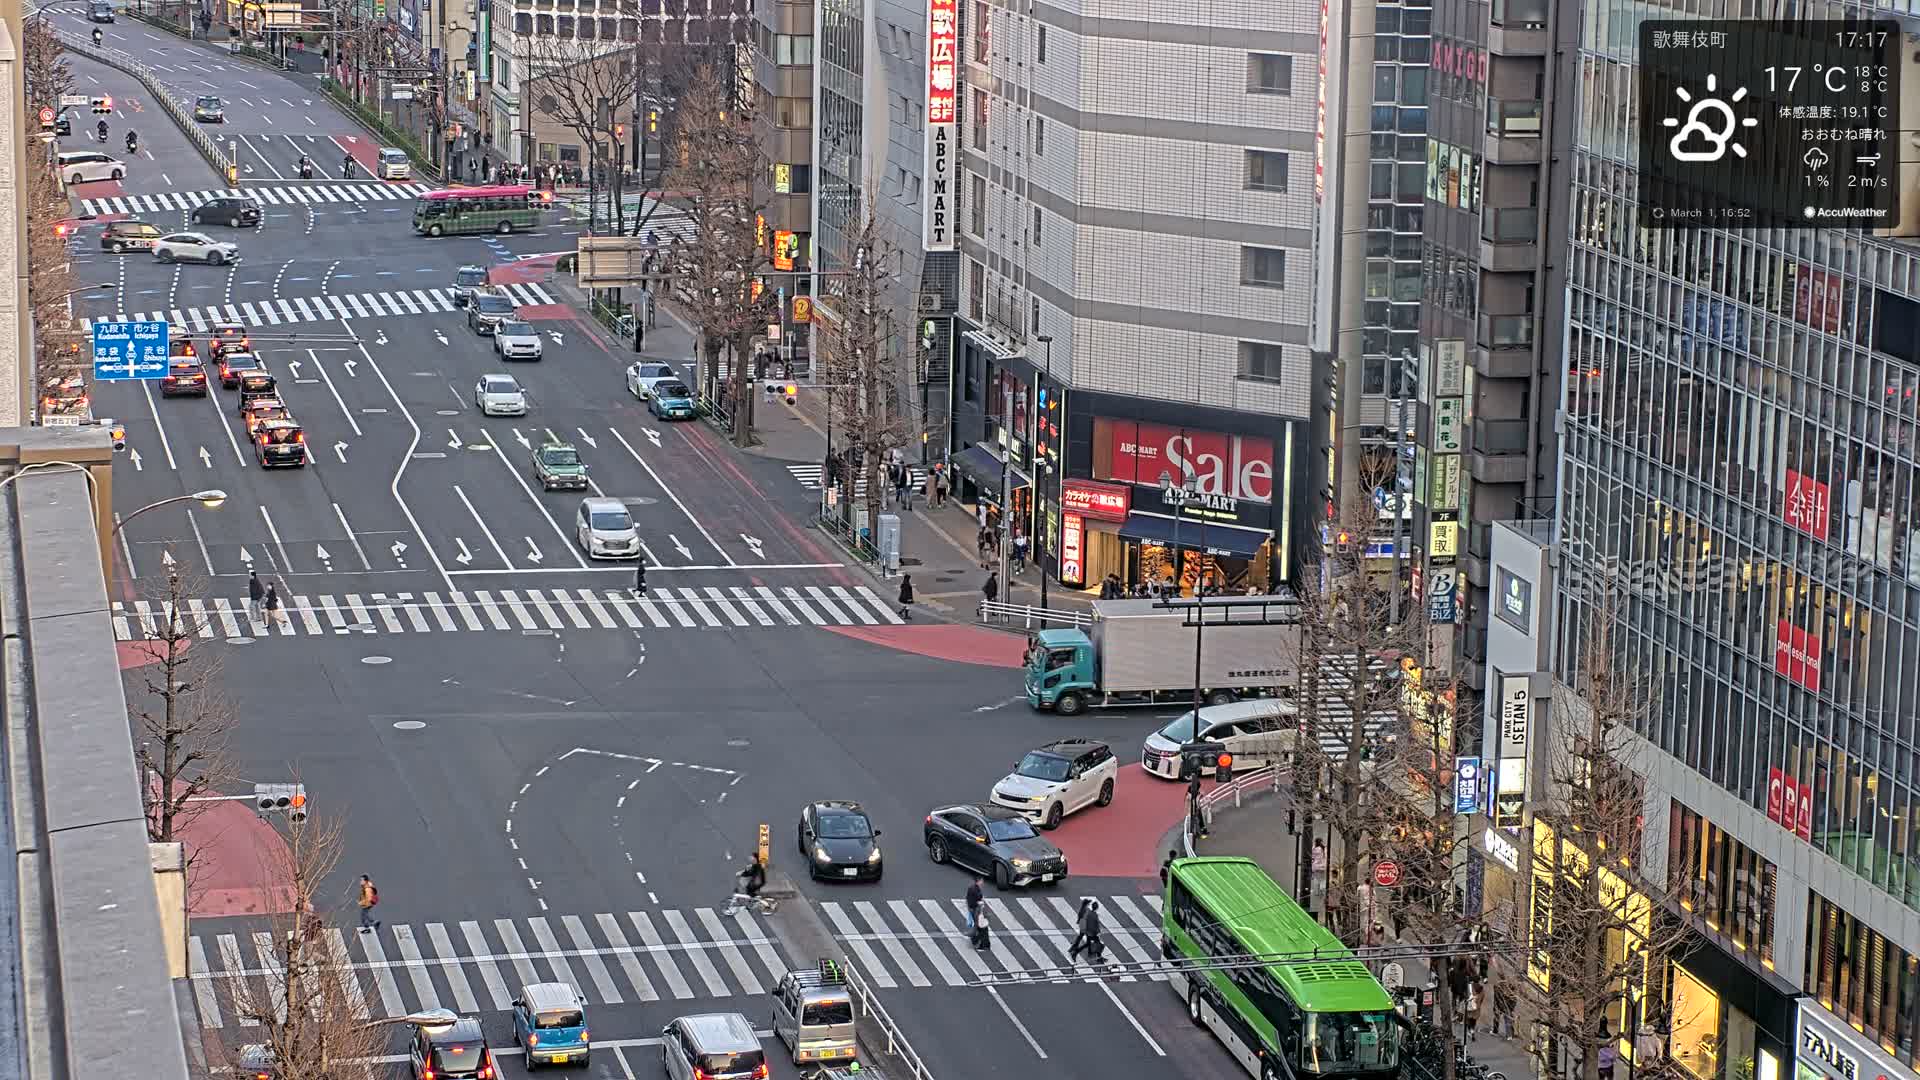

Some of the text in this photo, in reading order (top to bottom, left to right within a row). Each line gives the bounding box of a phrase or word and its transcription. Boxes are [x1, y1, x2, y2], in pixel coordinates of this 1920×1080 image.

[932, 0, 954, 90] 歌広場
[1433, 42, 1486, 82] AMIGO
[930, 97, 952, 108] 受付
[931, 109, 952, 119] 5F
[99, 324, 128, 333] 九段下
[144, 346, 166, 355] 渋谷
[1166, 435, 1273, 504] Sale
[1439, 512, 1450, 520] 7F
[1790, 481, 1825, 529] 会計
[1435, 525, 1447, 553] 買取
[1504, 700, 1513, 738] PARK CITY
[1512, 690, 1527, 745] ISETAN 5
[1770, 778, 1809, 828] CPA
